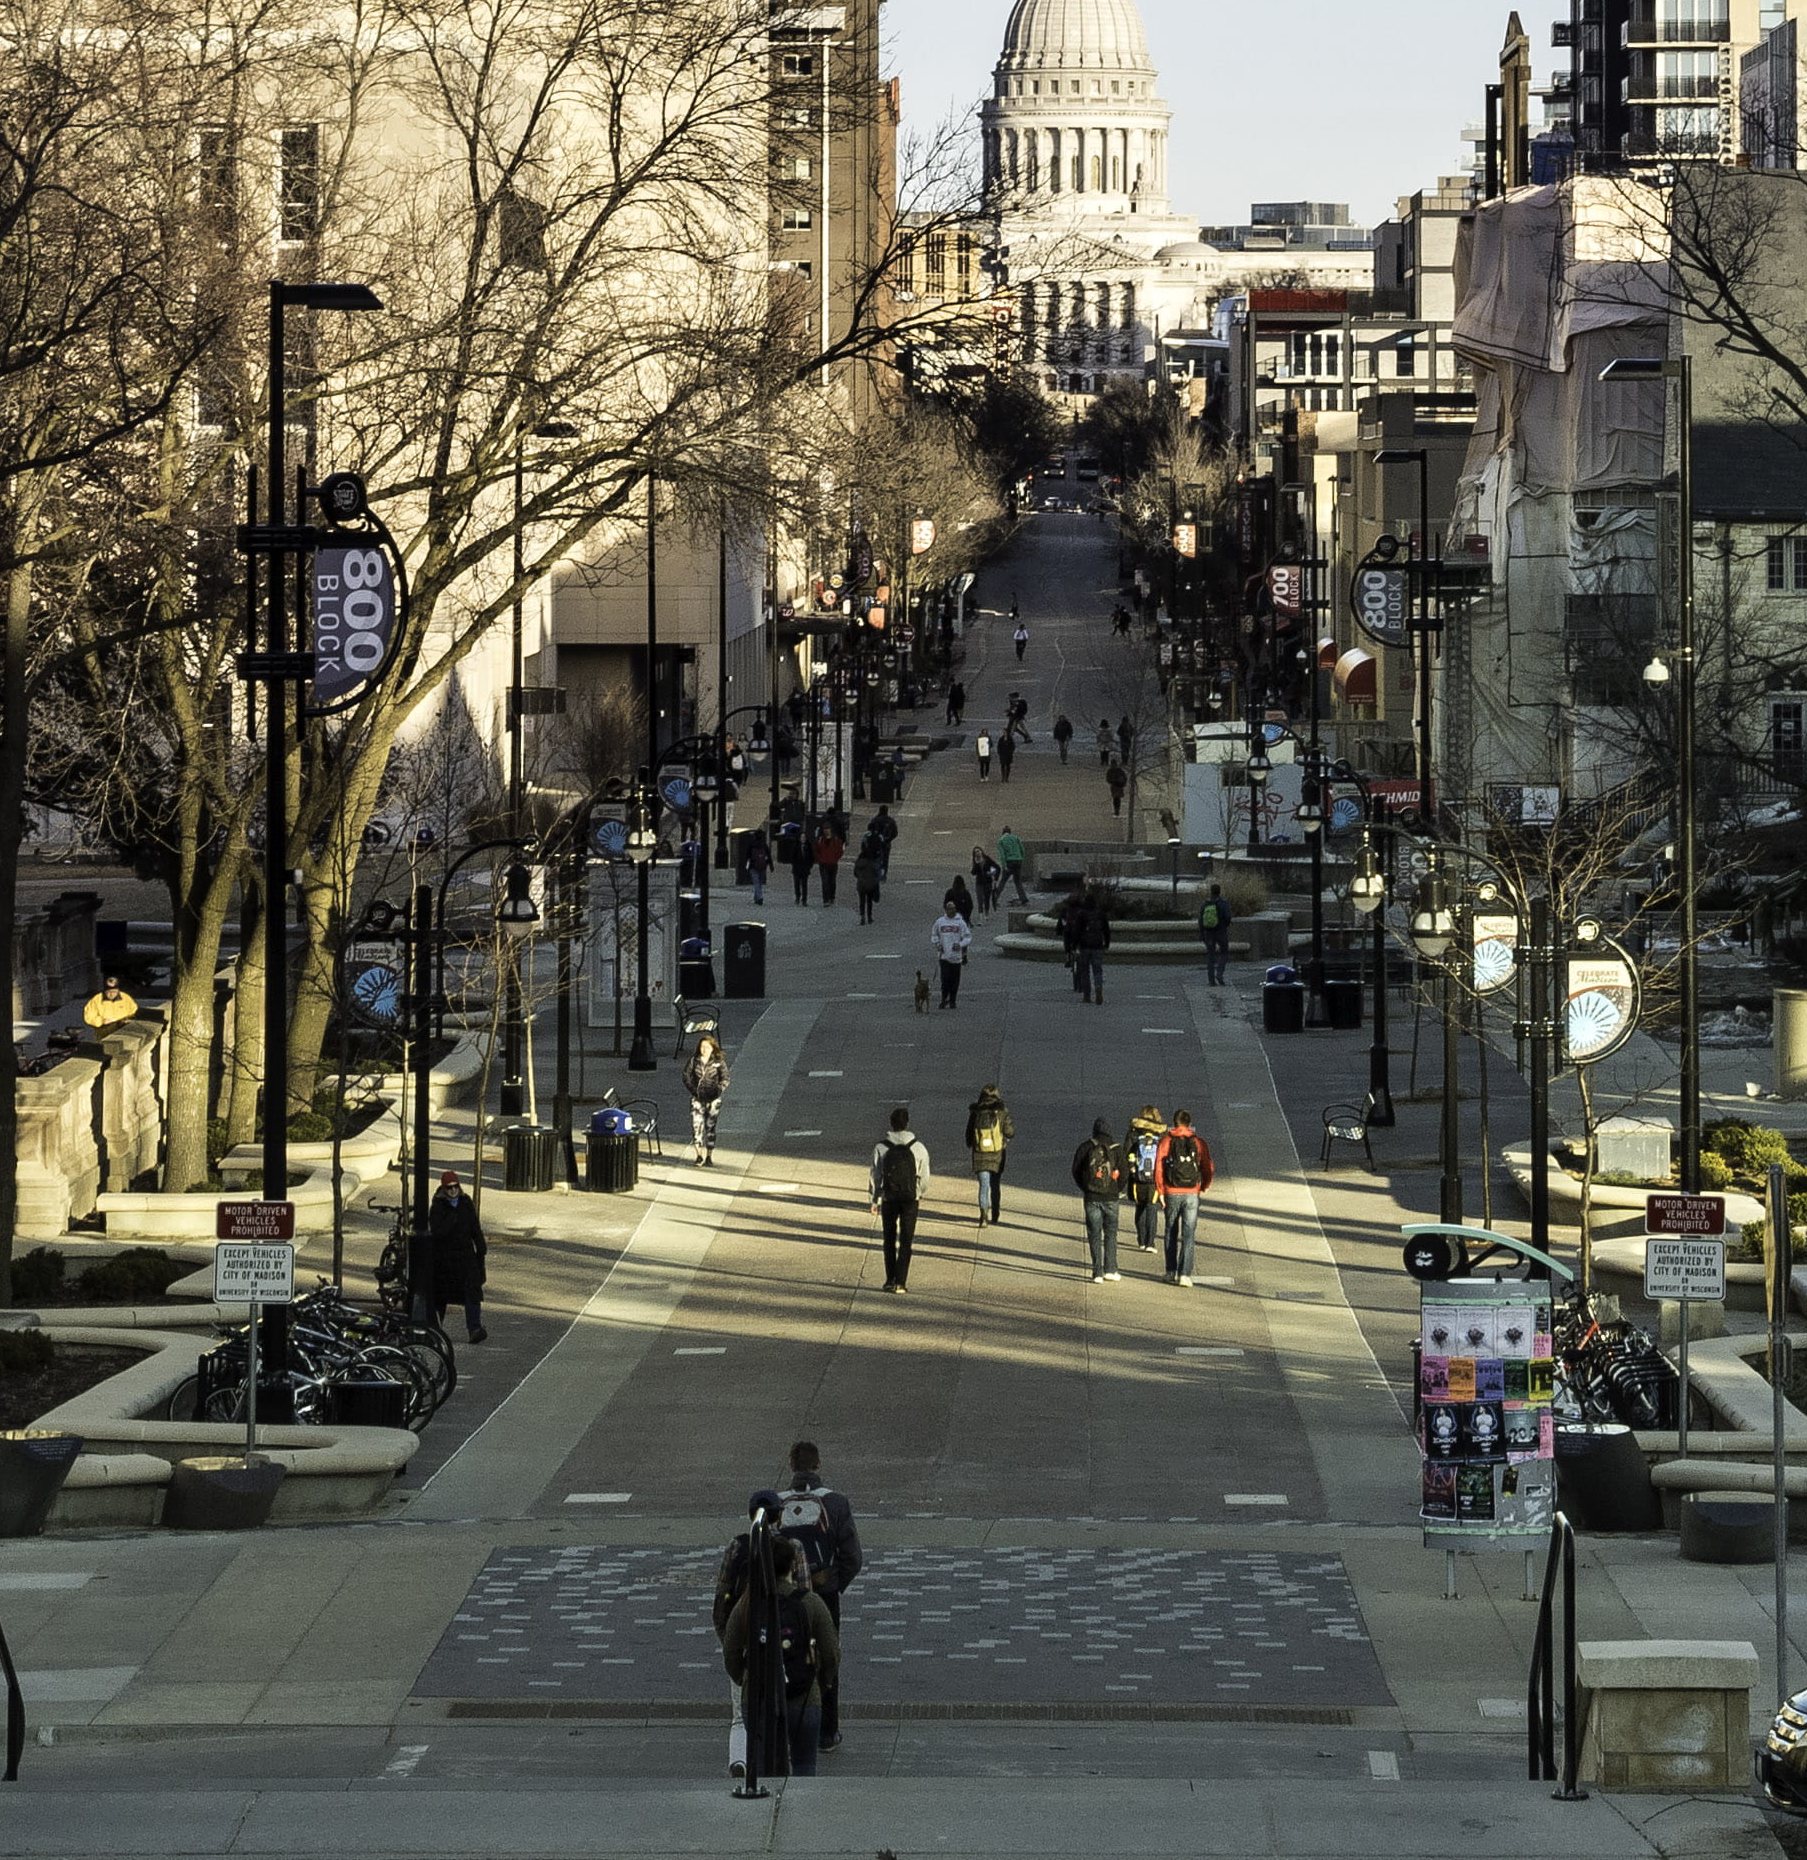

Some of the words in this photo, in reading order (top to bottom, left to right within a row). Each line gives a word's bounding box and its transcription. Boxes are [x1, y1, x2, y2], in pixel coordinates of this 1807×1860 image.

[1272, 567, 1290, 607] 700
[1289, 574, 1300, 608] BLOCK
[1362, 571, 1388, 629] 800
[342, 549, 385, 673] 800
[1388, 582, 1402, 630] BLOCK
[316, 573, 341, 674] BLOCK
[1371, 790, 1421, 804] HMID
[1398, 845, 1411, 886] BLOCK
[1575, 974, 1619, 984] Madison
[1655, 1200, 1683, 1210] MOTOR
[1686, 1200, 1717, 1210] DRIVEN
[225, 1206, 252, 1216] MOTOR
[256, 1206, 287, 1216] DRIVEN
[1666, 1210, 1706, 1220] VEHICLES
[235, 1216, 276, 1225] VEHICLES
[1661, 1220, 1710, 1230] PROHIBITED
[230, 1226, 280, 1236] PROHIBITED
[223, 1249, 250, 1259] EXCEPT
[253, 1249, 287, 1259] VEHICLES
[1653, 1244, 1680, 1255] EXCEPT
[1683, 1245, 1717, 1255] VEHICLES
[226, 1260, 271, 1269] AUTHORIZED
[274, 1260, 283, 1270] BY
[1656, 1256, 1702, 1266] AUTHORIZED
[1704, 1257, 1714, 1267] BY
[222, 1271, 239, 1280] CITY
[242, 1271, 251, 1280] OF
[254, 1271, 286, 1280] MADISON
[1653, 1267, 1669, 1276] CITY
[1672, 1267, 1681, 1276] OF
[1684, 1267, 1717, 1277] MADISON
